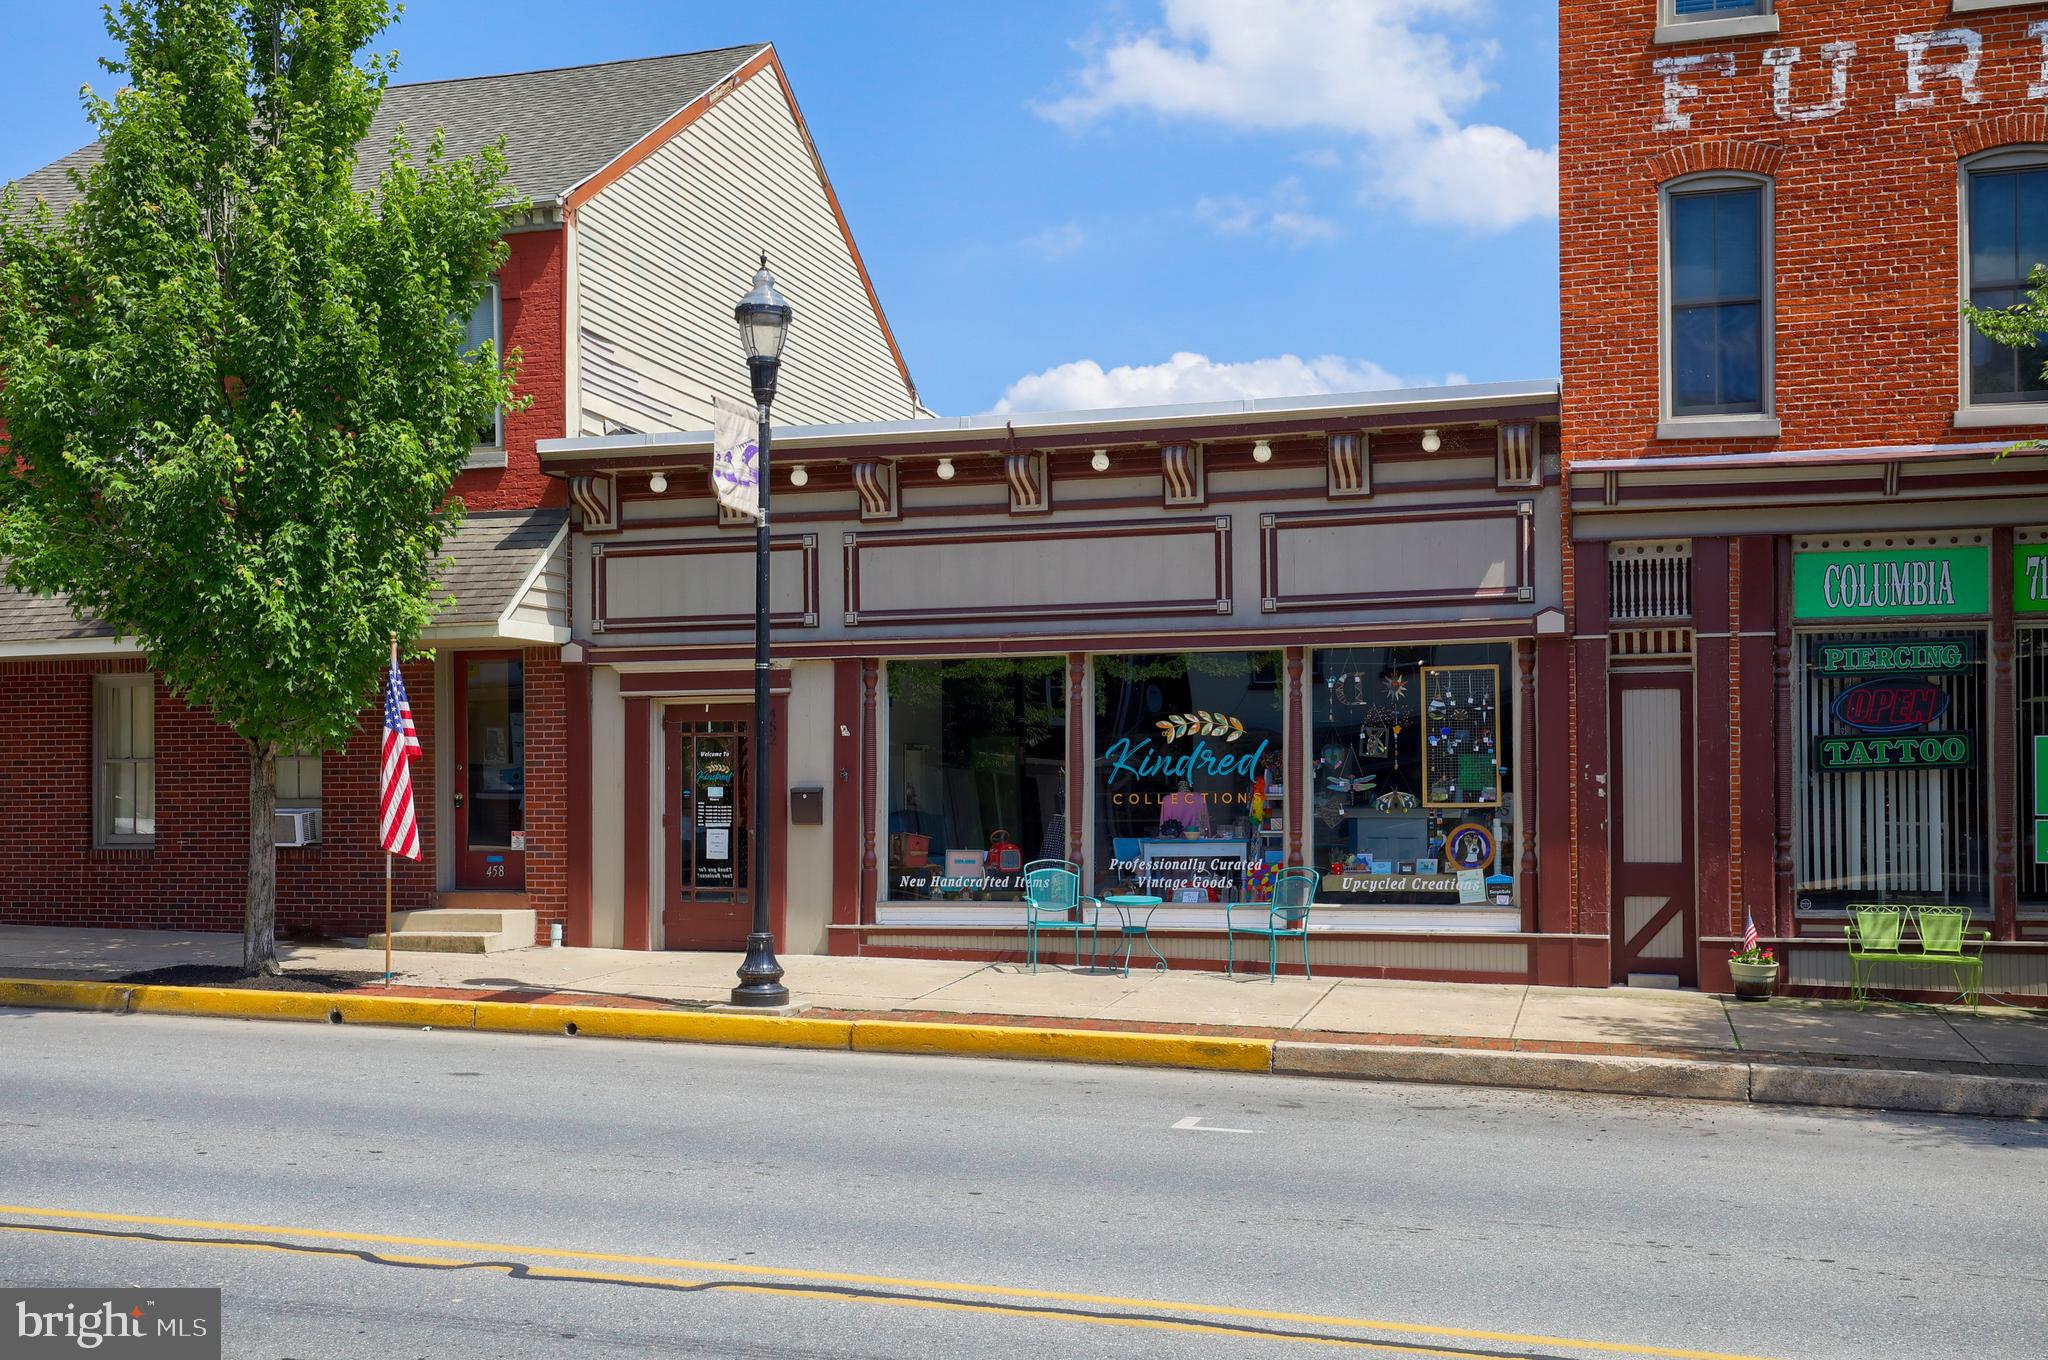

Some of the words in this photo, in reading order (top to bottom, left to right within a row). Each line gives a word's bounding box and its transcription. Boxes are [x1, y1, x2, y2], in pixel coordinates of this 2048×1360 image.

[1652, 20, 2048, 131] FUR
[1823, 560, 1955, 608] COLUMBIA
[1824, 645, 1962, 671] PIERCING
[1846, 688, 1937, 724] OPEN
[1105, 737, 1269, 785] Kindred
[1824, 738, 1966, 765] TATTOO
[1113, 792, 1263, 805] COLLECTIONS
[486, 865, 505, 878] 458
[1109, 858, 1206, 873] Professionally
[1210, 858, 1263, 871] Curated
[900, 876, 926, 888] New
[930, 876, 1009, 891] Handcrafted
[1014, 876, 1050, 888] Items
[1137, 877, 1187, 890] Vintage
[1192, 876, 1233, 889] Goods
[1342, 877, 1406, 893] Upcycled
[1411, 877, 1480, 891] Creations
